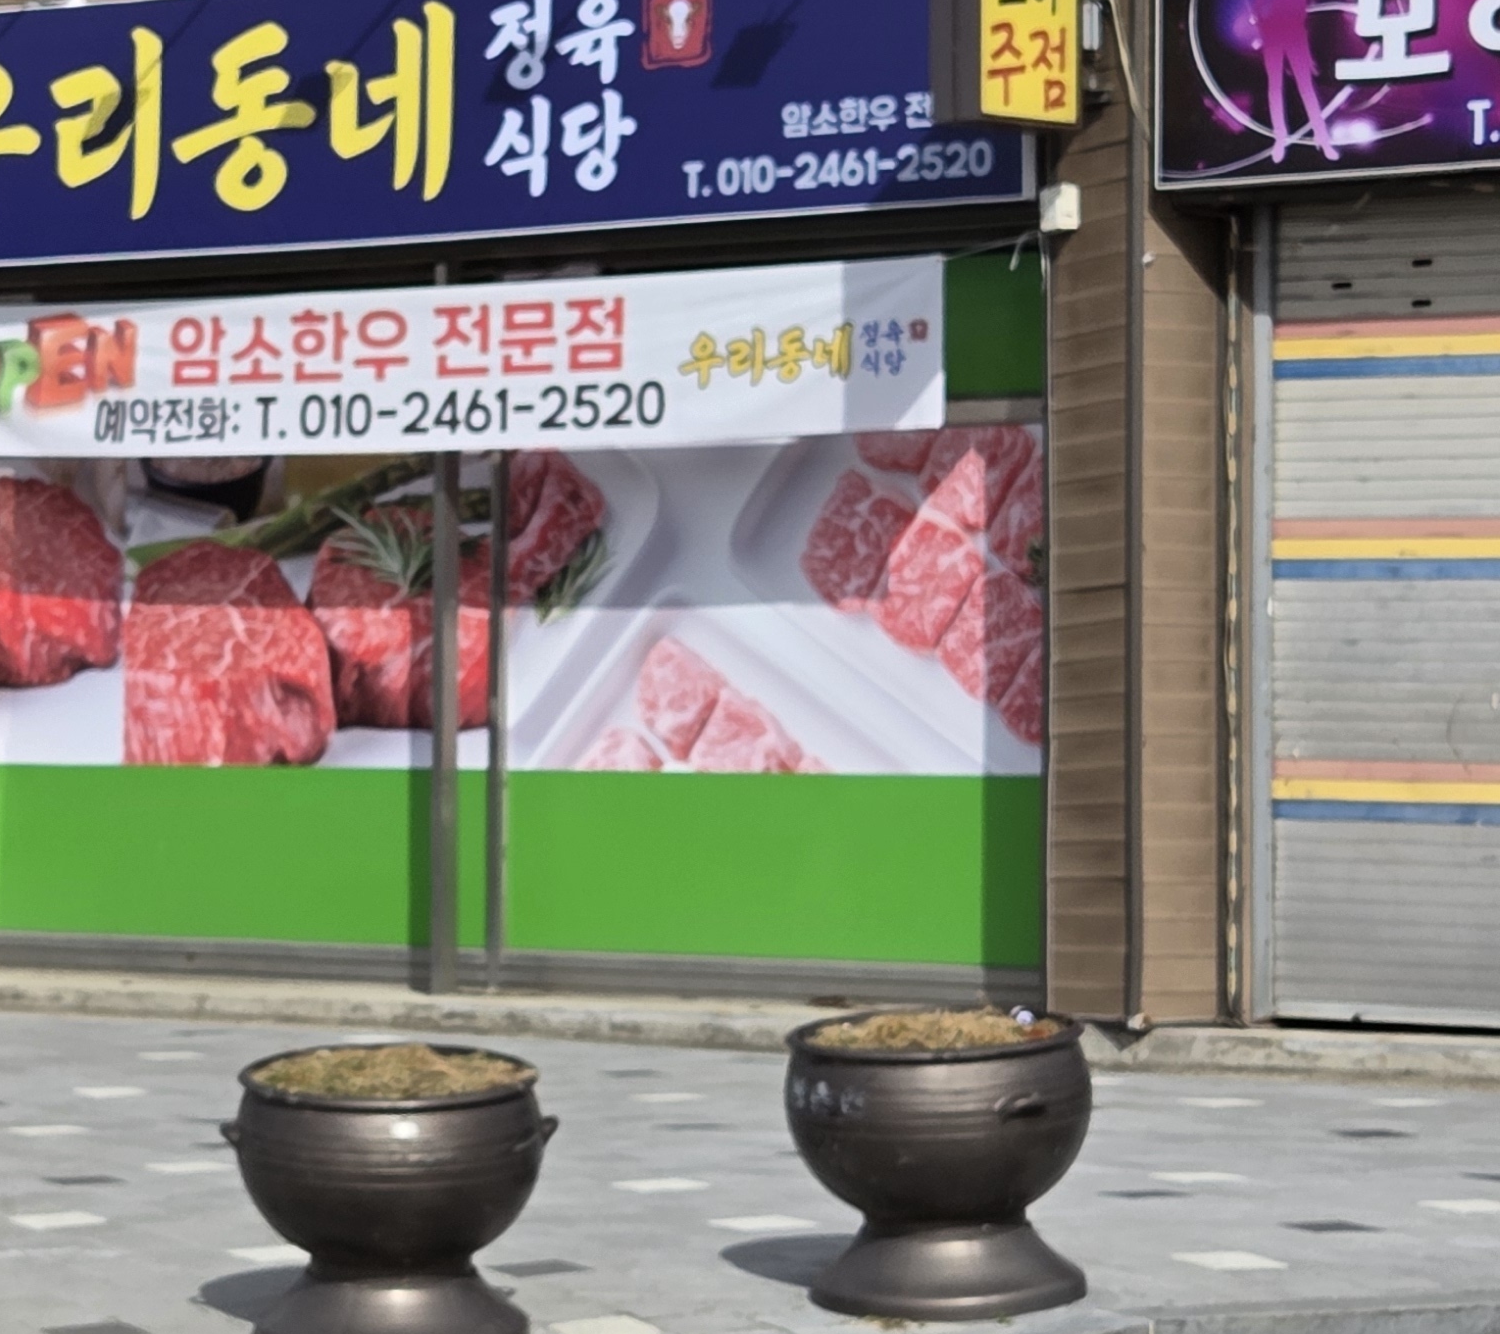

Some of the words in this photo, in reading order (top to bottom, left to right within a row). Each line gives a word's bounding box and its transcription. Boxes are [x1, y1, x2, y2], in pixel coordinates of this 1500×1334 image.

[987, 22, 1069, 112] 주점
[485, 89, 638, 198] 식당
[781, 94, 898, 138] 암소한우
[682, 139, 996, 199] T.010-2461-2520
[169, 308, 410, 387] 암소한우
[432, 295, 625, 379] 전문점
[678, 321, 854, 391] 우리동네
[860, 318, 905, 348] 정육
[860, 348, 906, 377] 식당
[94, 395, 241, 444] 예약전화:
